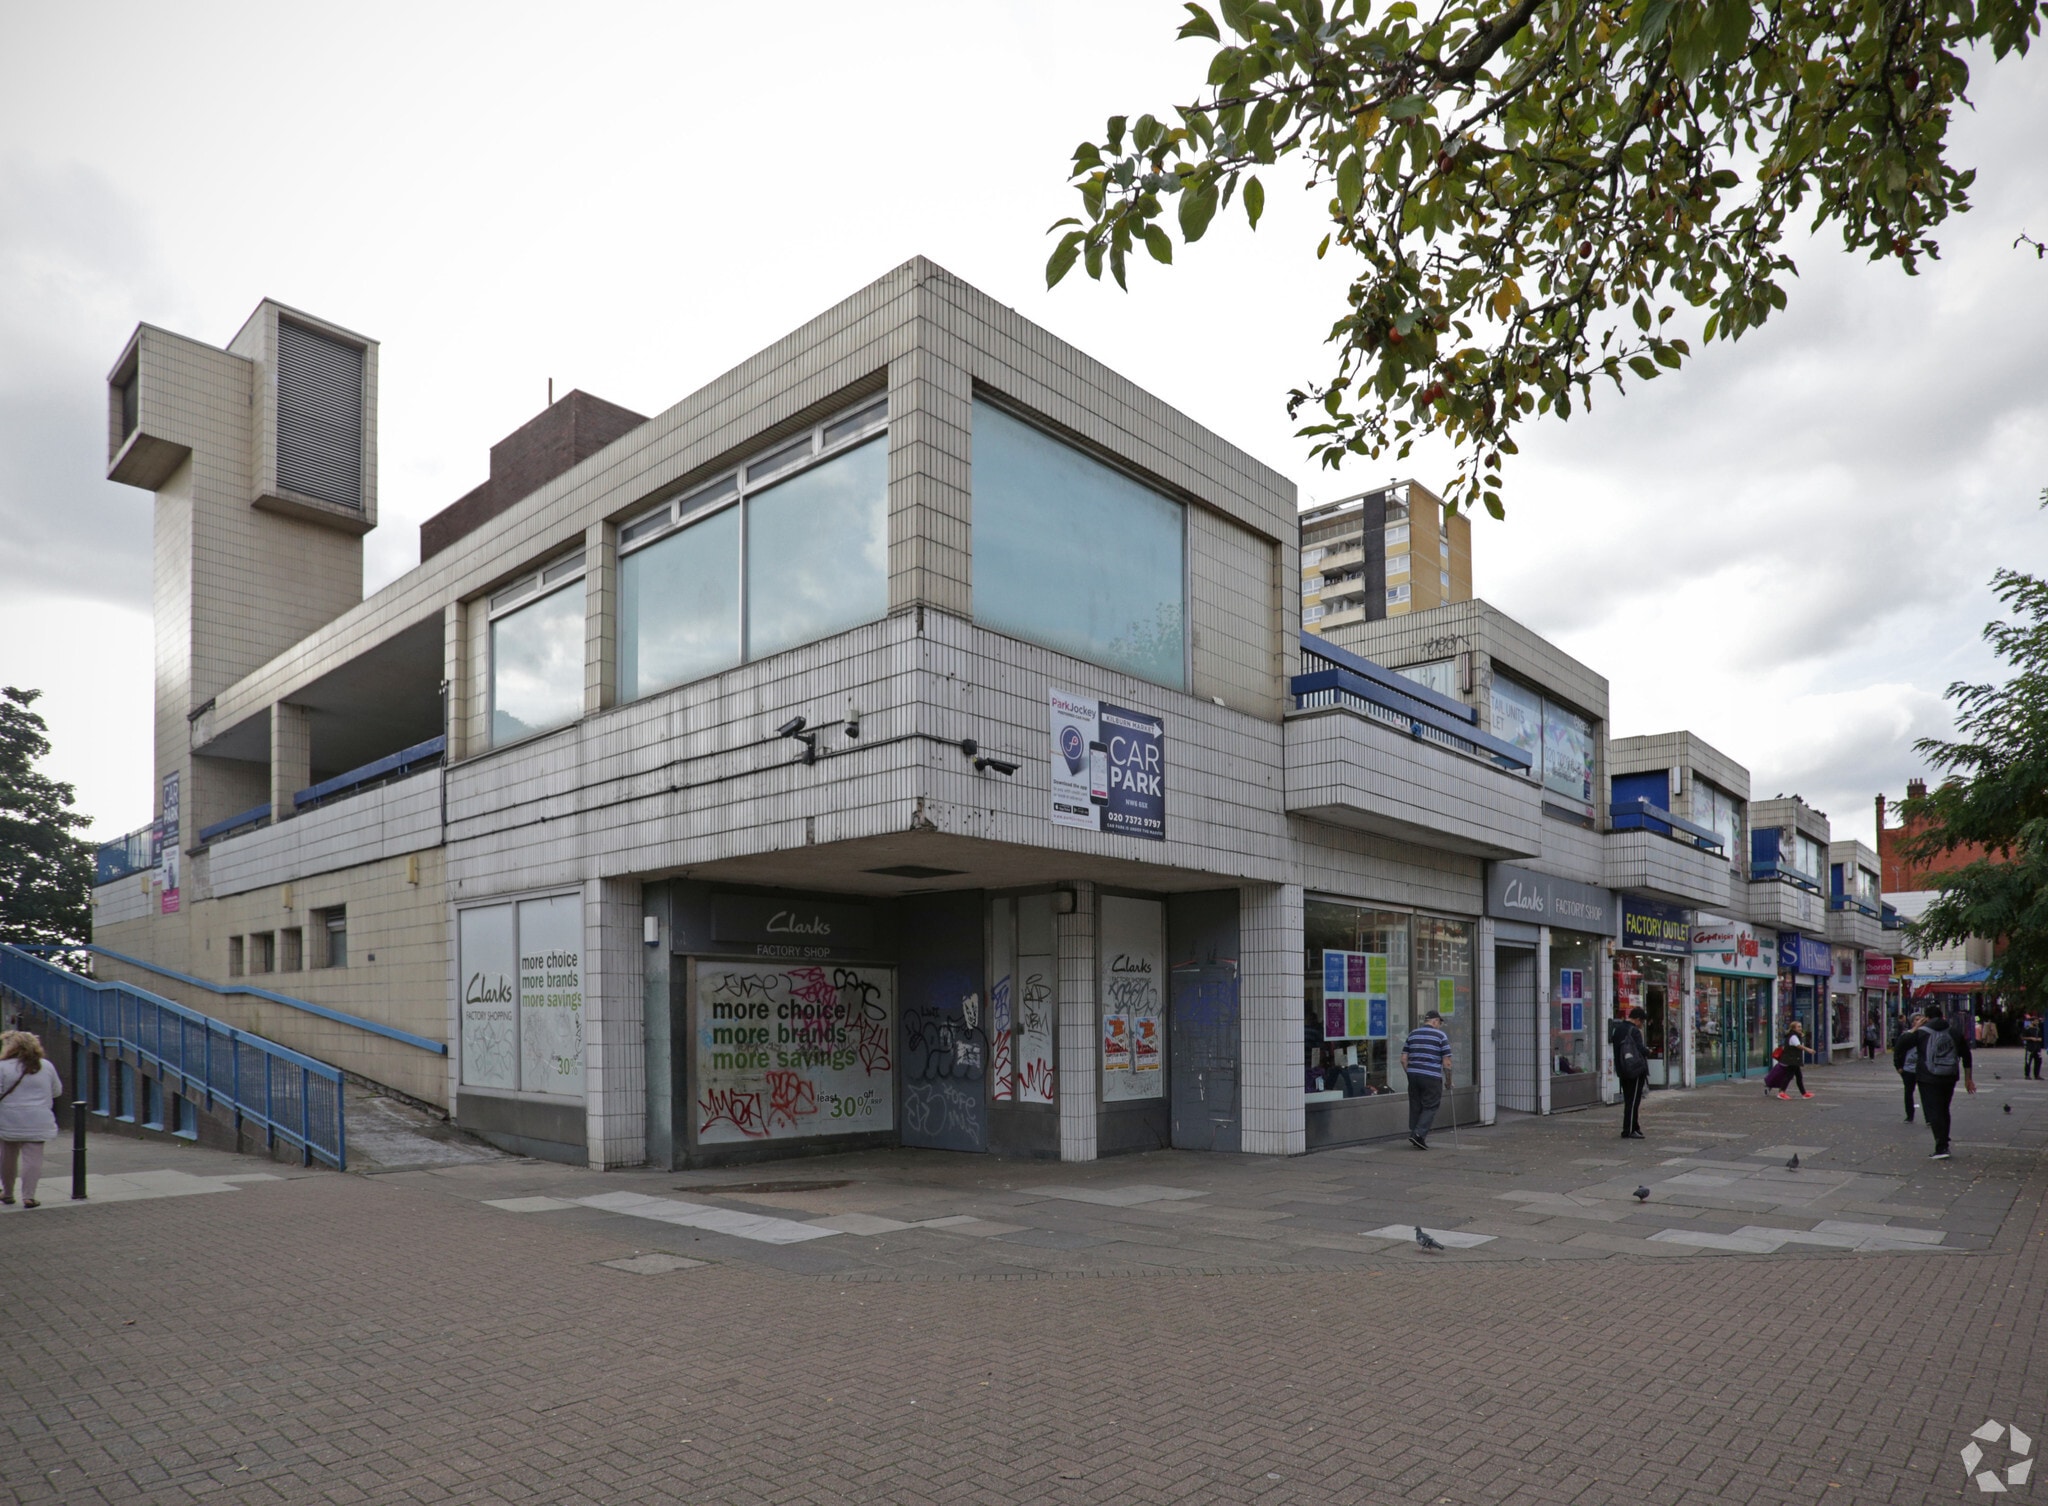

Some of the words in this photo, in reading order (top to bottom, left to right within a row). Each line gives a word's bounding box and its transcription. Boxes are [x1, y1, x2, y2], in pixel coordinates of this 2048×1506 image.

[1052, 698, 1096, 719] ParkJockey
[1506, 703, 1525, 725] UNITS
[1106, 716, 1131, 728] KILBURN
[1132, 722, 1154, 733] MARKET
[1492, 713, 1504, 731] LET
[1110, 736, 1160, 773] CAR
[1110, 766, 1162, 797] PARK
[164, 782, 179, 808] CAR
[164, 806, 179, 825] PARK
[1108, 812, 1123, 822] 020
[1125, 814, 1142, 825] 7372
[1144, 818, 1161, 828] 9797
[1504, 879, 1544, 912] Clarks
[1555, 898, 1584, 918] FACTORY
[1585, 904, 1603, 921] SHOP
[766, 911, 831, 935] Clarks
[1626, 912, 1662, 937] FACTORY
[1663, 920, 1689, 942] OUTLET
[522, 955, 544, 970] more
[547, 951, 578, 968] choice
[757, 945, 801, 957] FACTORY
[804, 947, 830, 958] SHOP
[1112, 954, 1151, 973] Clarks
[466, 972, 512, 1004] Clarks
[522, 973, 544, 989] more
[547, 970, 578, 987] brands
[522, 993, 544, 1008] more
[547, 990, 582, 1011] savings
[713, 1002, 769, 1019] more
[777, 999, 846, 1020] choice
[466, 1011, 486, 1021] FACTORY
[487, 1011, 512, 1021] SHOPPING
[713, 1027, 769, 1044] more
[778, 1023, 847, 1044] brands
[713, 1051, 770, 1070] more
[777, 1047, 856, 1071] savings
[817, 1094, 838, 1103] least
[830, 1096, 872, 1118] 30%
